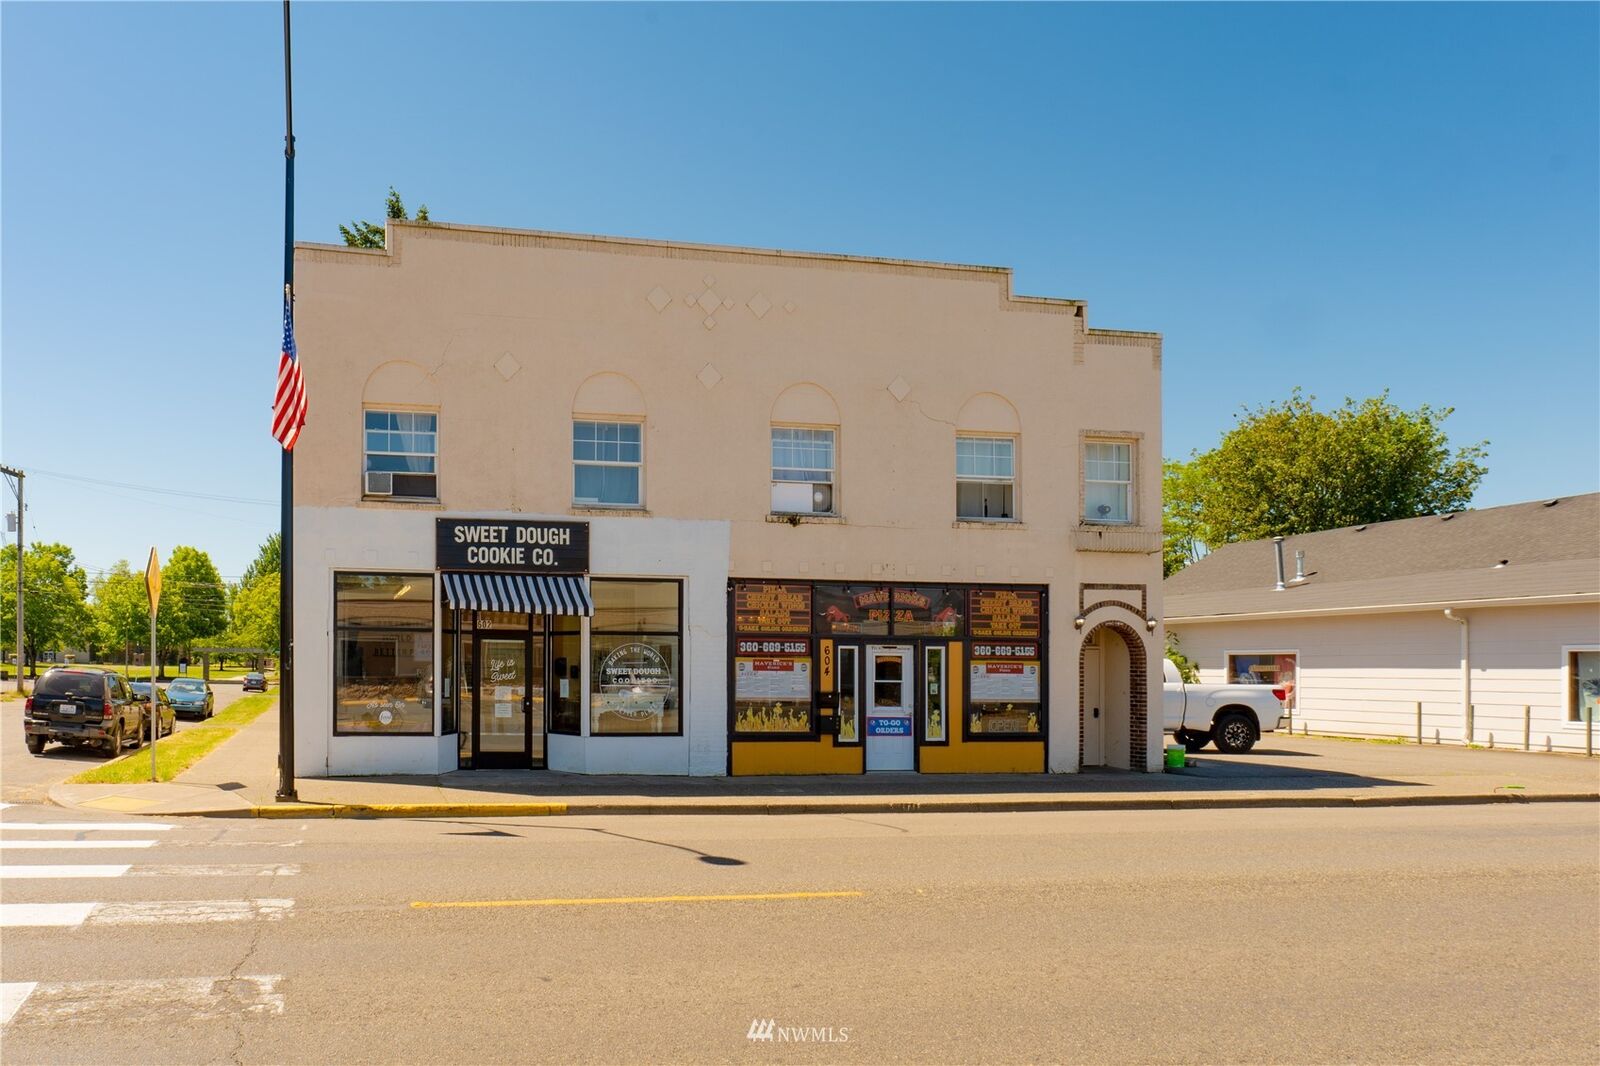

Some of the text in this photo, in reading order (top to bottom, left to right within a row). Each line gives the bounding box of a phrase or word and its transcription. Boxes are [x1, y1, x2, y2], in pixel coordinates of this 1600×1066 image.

[454, 525, 571, 545] SWEET DOUGH
[467, 546, 559, 566] COOKIE CO.
[868, 609, 914, 622] PIZZA
[490, 671, 517, 682] Sweet
